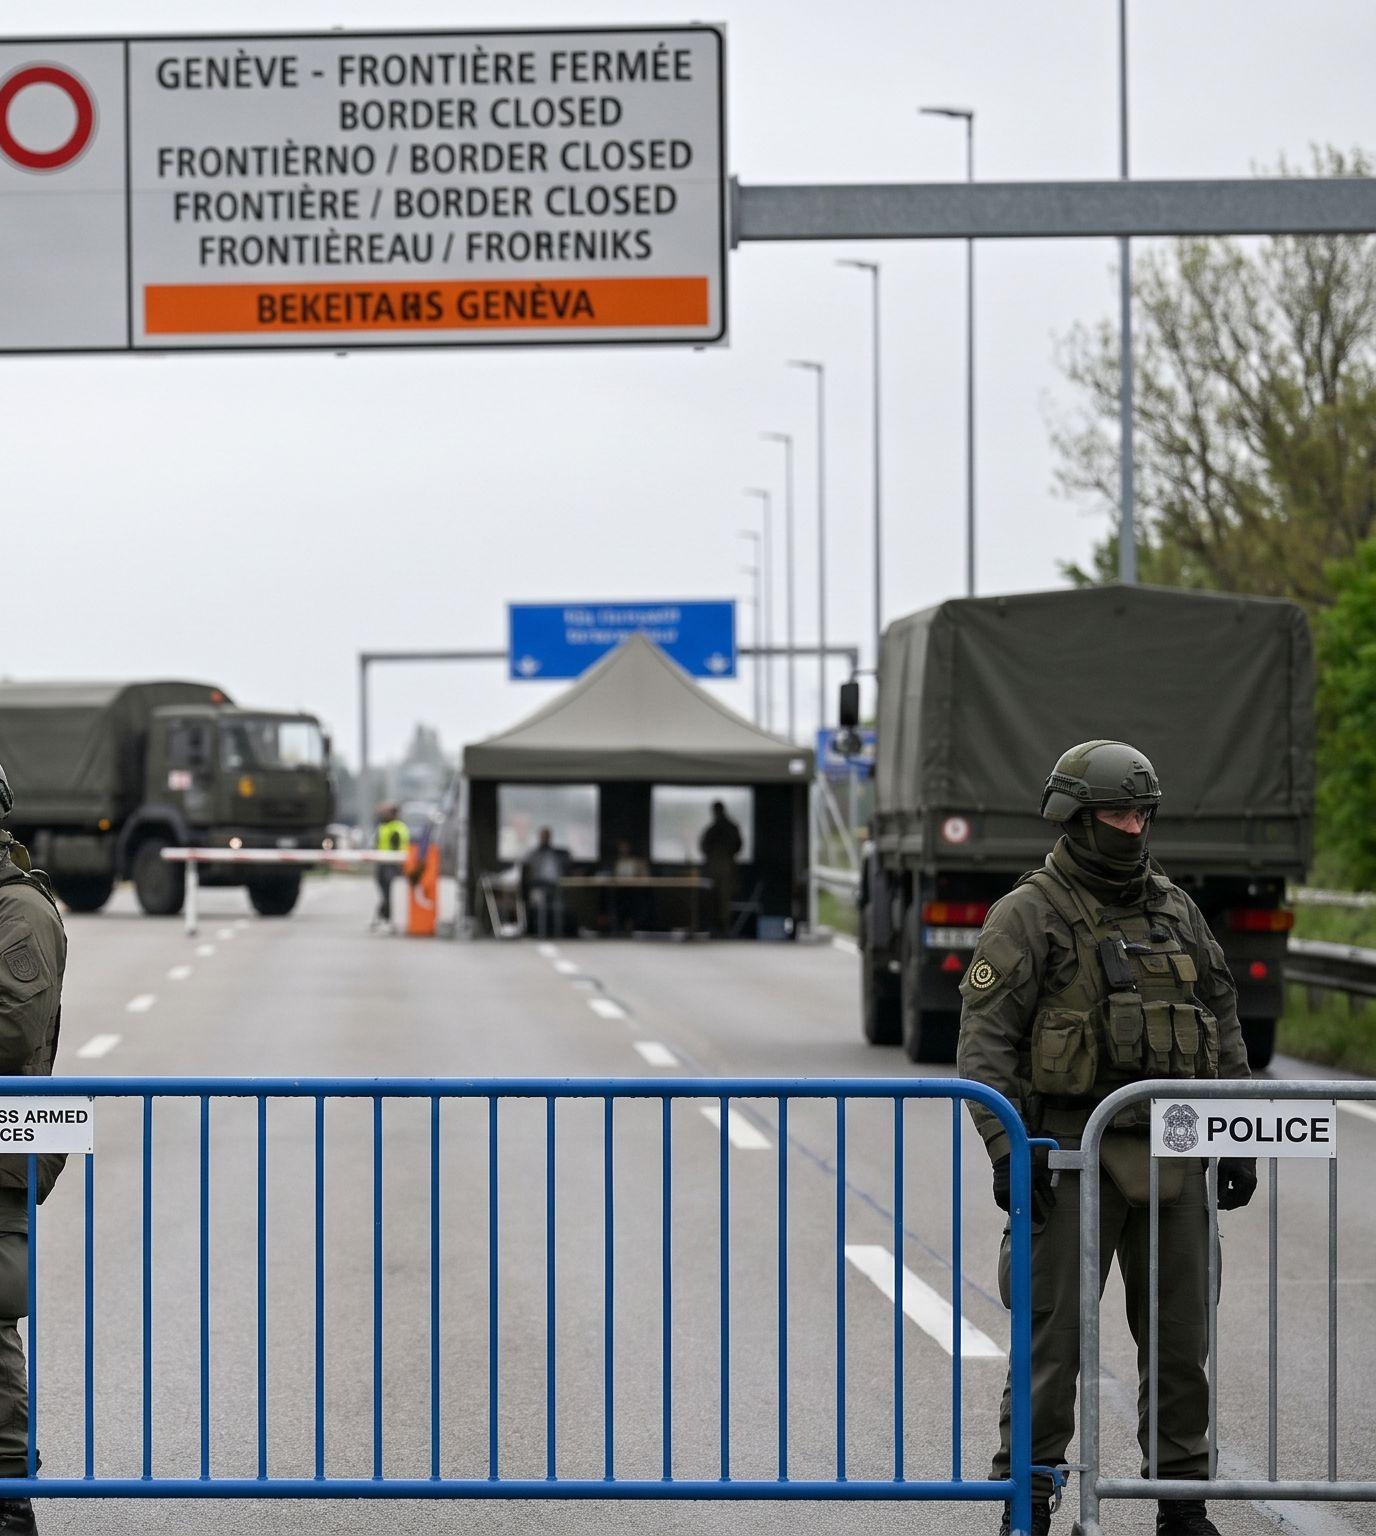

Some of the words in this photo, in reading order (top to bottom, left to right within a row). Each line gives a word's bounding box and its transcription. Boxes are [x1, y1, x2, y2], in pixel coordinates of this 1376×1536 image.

[156, 49, 298, 90] GENÈVE
[338, 46, 536, 87] FRONTIÈRE
[550, 42, 692, 83] FERMÉE
[339, 98, 478, 131] BORDER
[490, 96, 623, 129] CLOSED
[158, 139, 376, 178] FRONTIÈRNO
[410, 141, 548, 174] BORDER
[560, 139, 693, 172] CLOSED
[173, 183, 359, 222] FRONTIÈRE
[394, 186, 532, 219] BORDER
[545, 184, 678, 217] CLOSED
[199, 228, 433, 266] FRONTIÈREAU
[456, 282, 595, 322] GENÈVA
[23, 1109, 88, 1124] ARMED
[1207, 1116, 1330, 1143] POLICE
